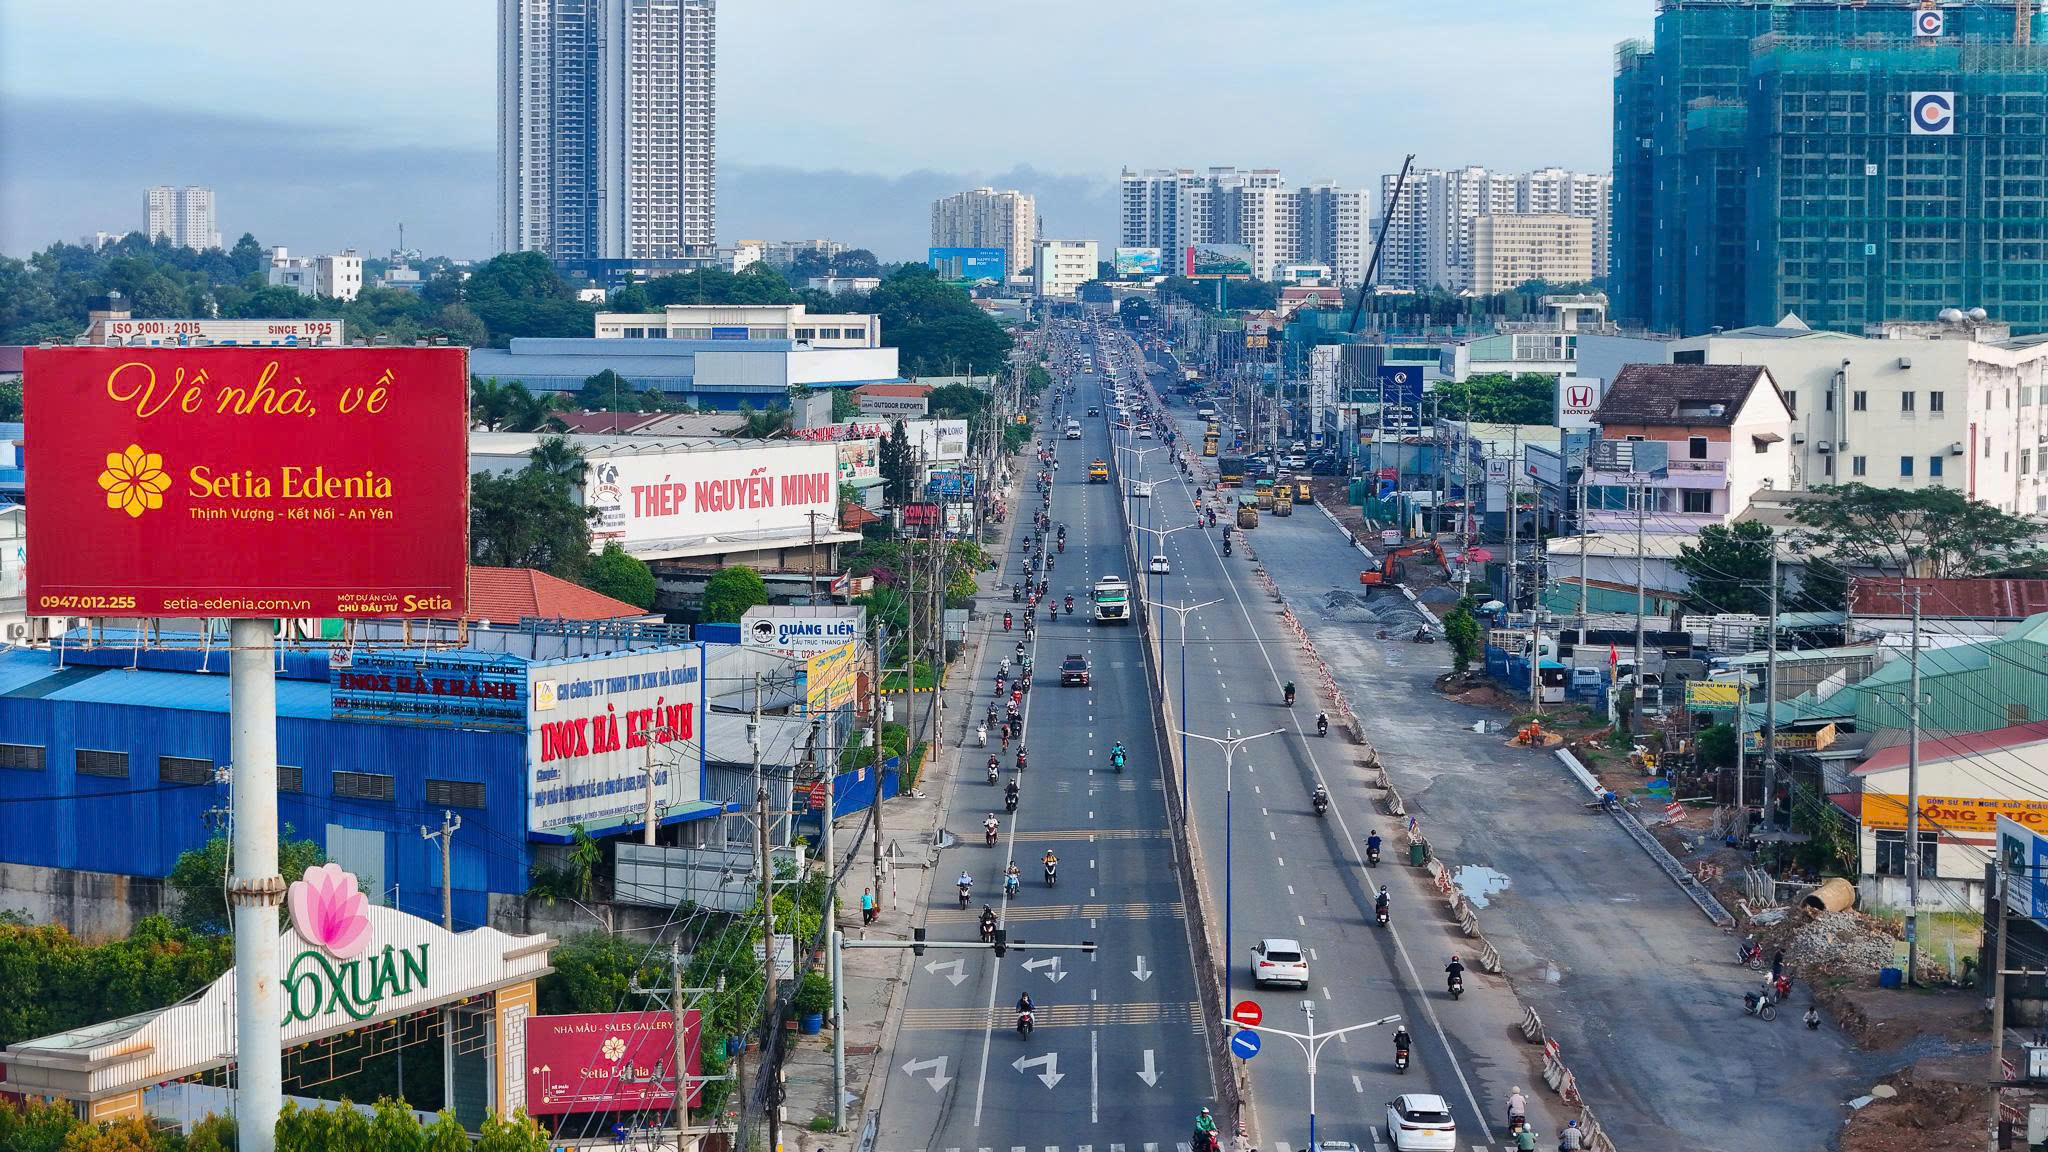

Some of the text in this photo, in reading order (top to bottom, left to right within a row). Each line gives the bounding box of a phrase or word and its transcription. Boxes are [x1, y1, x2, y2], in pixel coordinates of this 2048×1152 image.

[112, 323, 132, 334] ISO
[268, 323, 332, 334] SINCE 1995
[106, 360, 396, 418] Về nhà, về
[873, 401, 898, 409] OUTDOOR
[900, 402, 923, 410] EXPORTS
[949, 426, 964, 435] LONG
[189, 465, 393, 499] Setia Edenia
[631, 467, 830, 518] THÉP NGUYỄN MINH
[189, 507, 227, 520] Thịnh
[231, 508, 274, 522] Vượng
[288, 507, 311, 520] Kết
[313, 507, 335, 520] Nối
[349, 508, 366, 520] An
[369, 507, 393, 520] Yên
[40, 596, 136, 609] 0947.012.255
[163, 596, 311, 610] setia-edenia.com.vn
[338, 593, 398, 602] MỘT DỰ ÁN CỦA
[403, 594, 452, 613] Setia
[338, 602, 398, 613] CHỦ ĐẦU TƯ
[779, 620, 855, 645] QUẢNG LIÊN
[340, 671, 518, 700] INOX HÀ KHÁNH
[556, 663, 698, 700] CN CÔNG TY TNHH TM XNK HÀ KHÁNH
[541, 718, 589, 763] INOX
[592, 702, 621, 754] HÀ
[554, 1024, 574, 1034] NHÀ
[575, 1023, 597, 1034] MẪU
[605, 1023, 631, 1032] SALES
[634, 1021, 674, 1031] GALLERY
[580, 1066, 609, 1079] Setia
